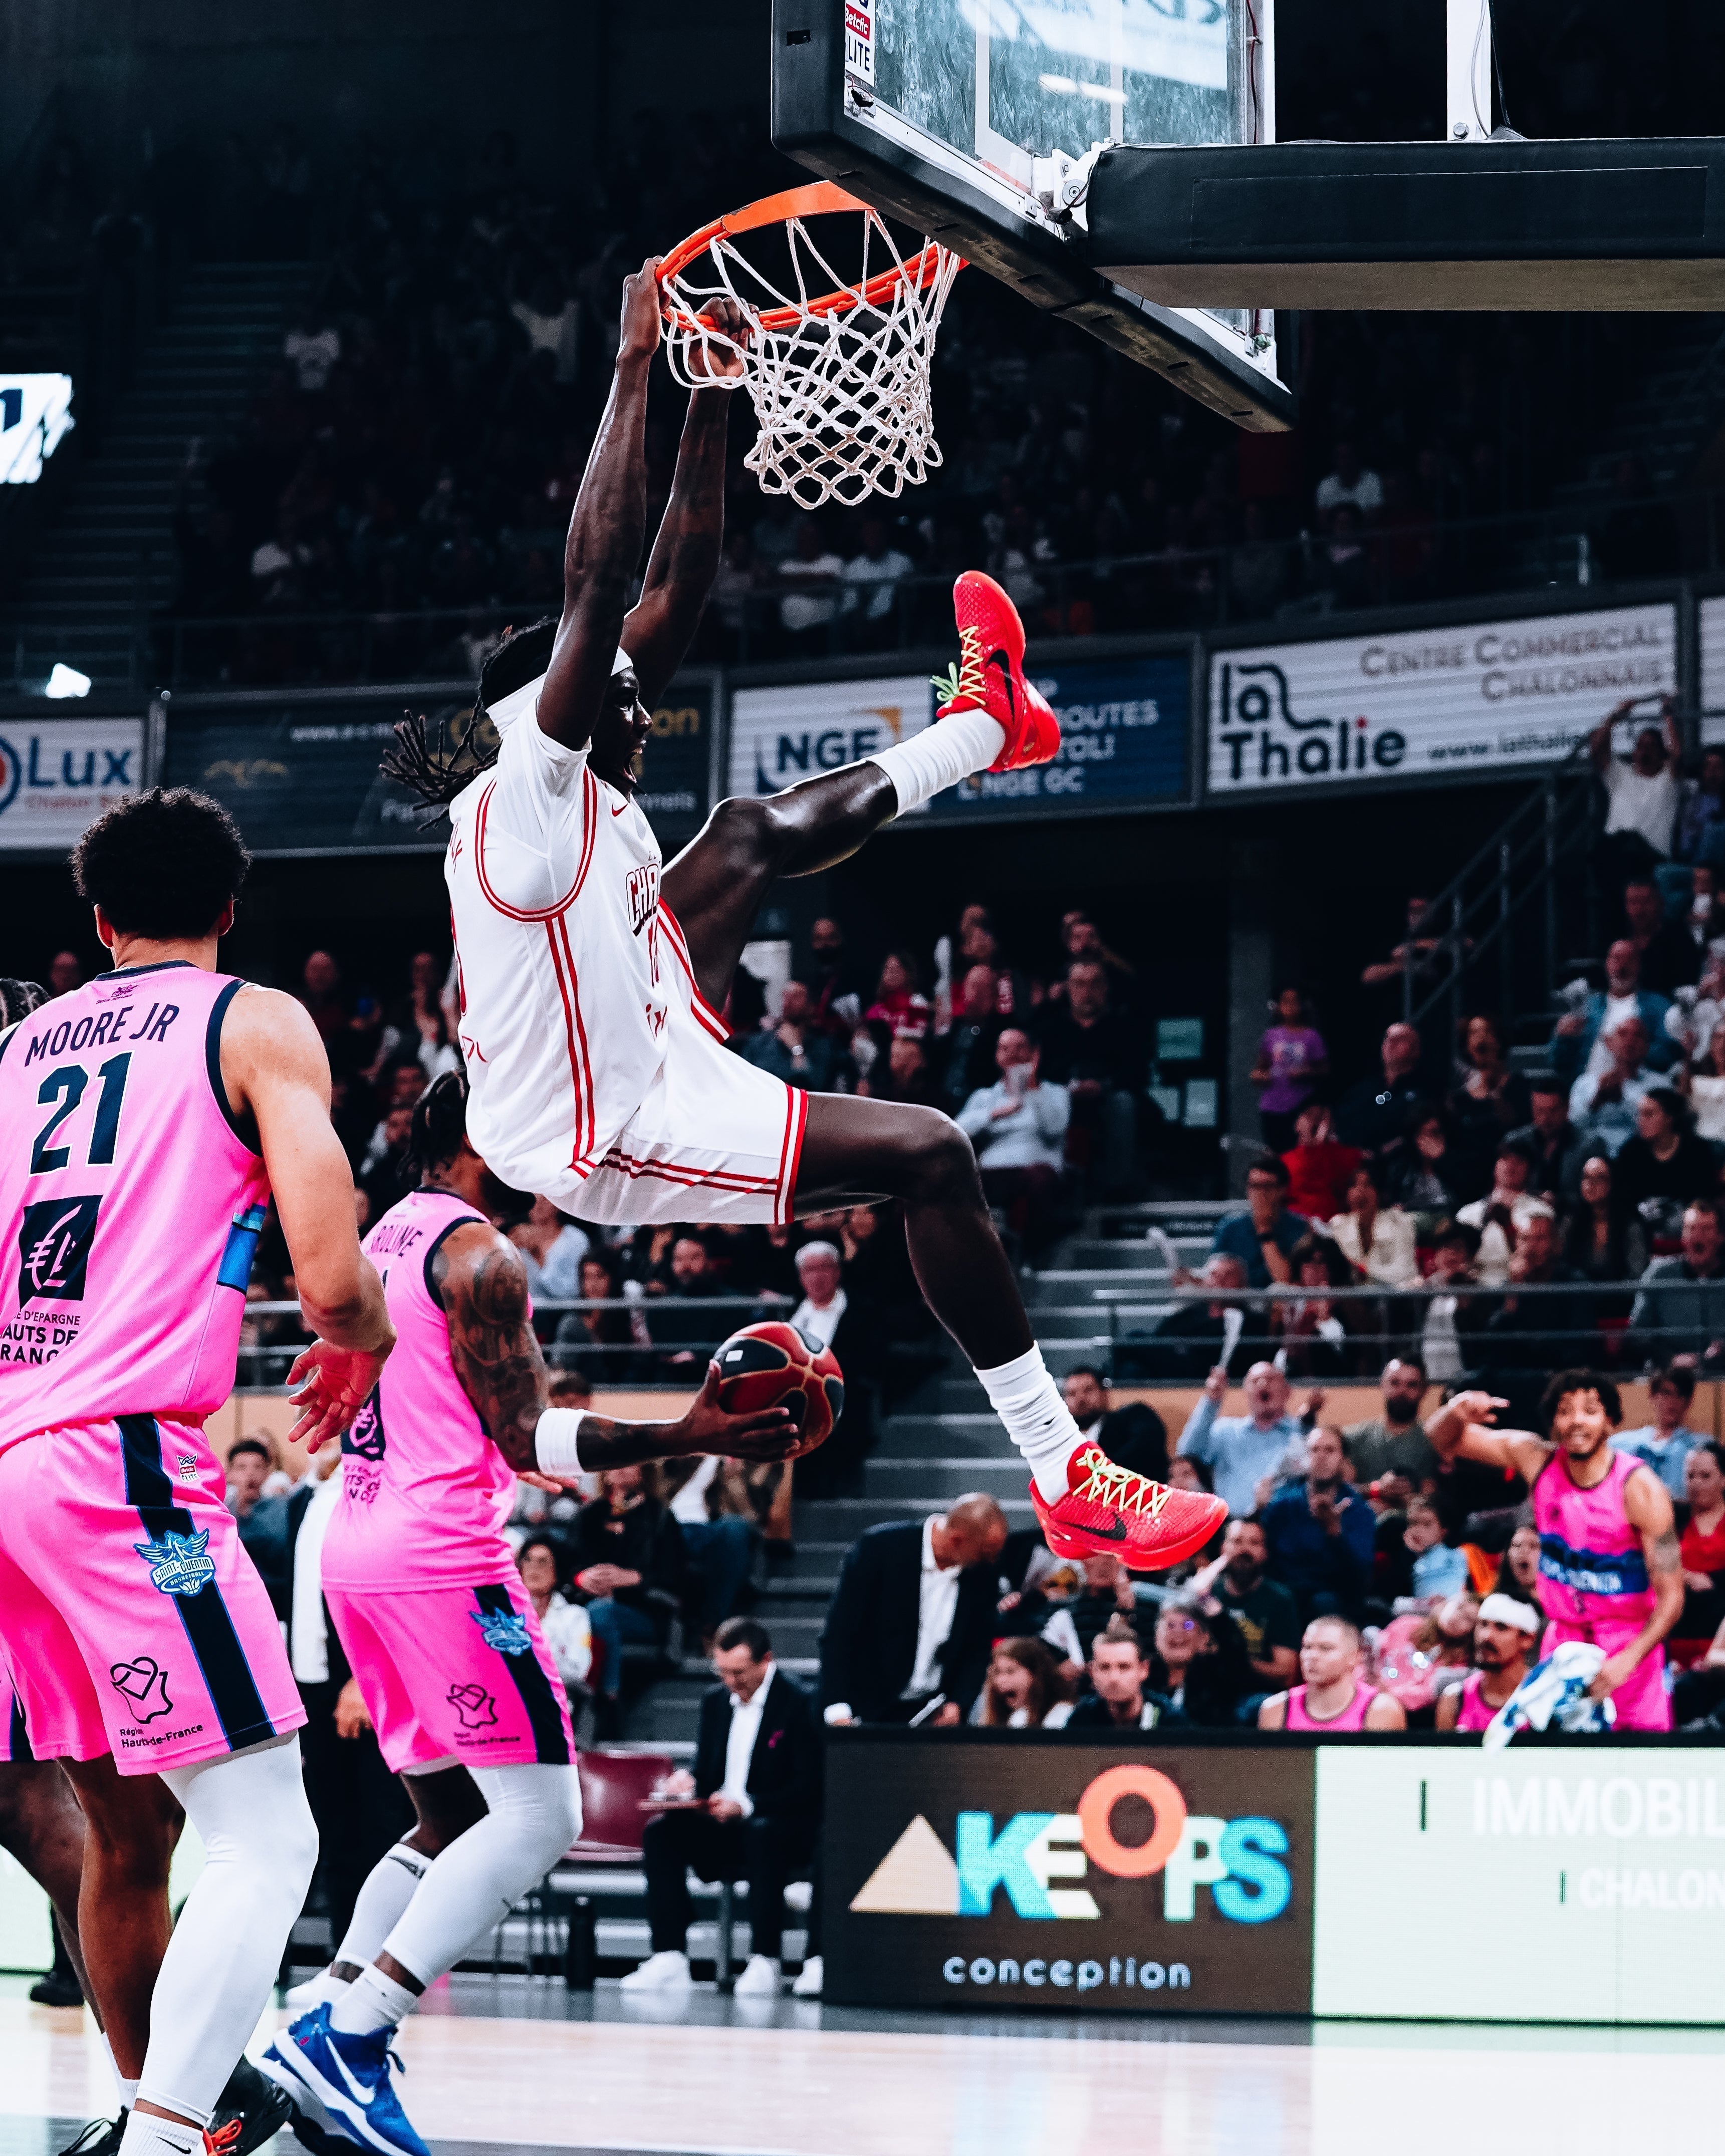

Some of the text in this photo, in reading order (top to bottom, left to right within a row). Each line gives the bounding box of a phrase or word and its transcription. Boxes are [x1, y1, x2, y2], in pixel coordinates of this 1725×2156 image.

[848, 35, 870, 72] LITE
[1221, 715, 1407, 780] Thalie
[25, 1002, 180, 1067] MOORE JR
[28, 1049, 135, 1177] 21
[0, 1323, 47, 1344] AUTS
[24, 1310, 81, 1326] D'EPARGNE
[0, 1343, 59, 1365] RANC
[1473, 1776, 1725, 1838] IMMOBIL
[956, 1764, 1292, 1924] KEOPS
[943, 1955, 1191, 1992] conception
